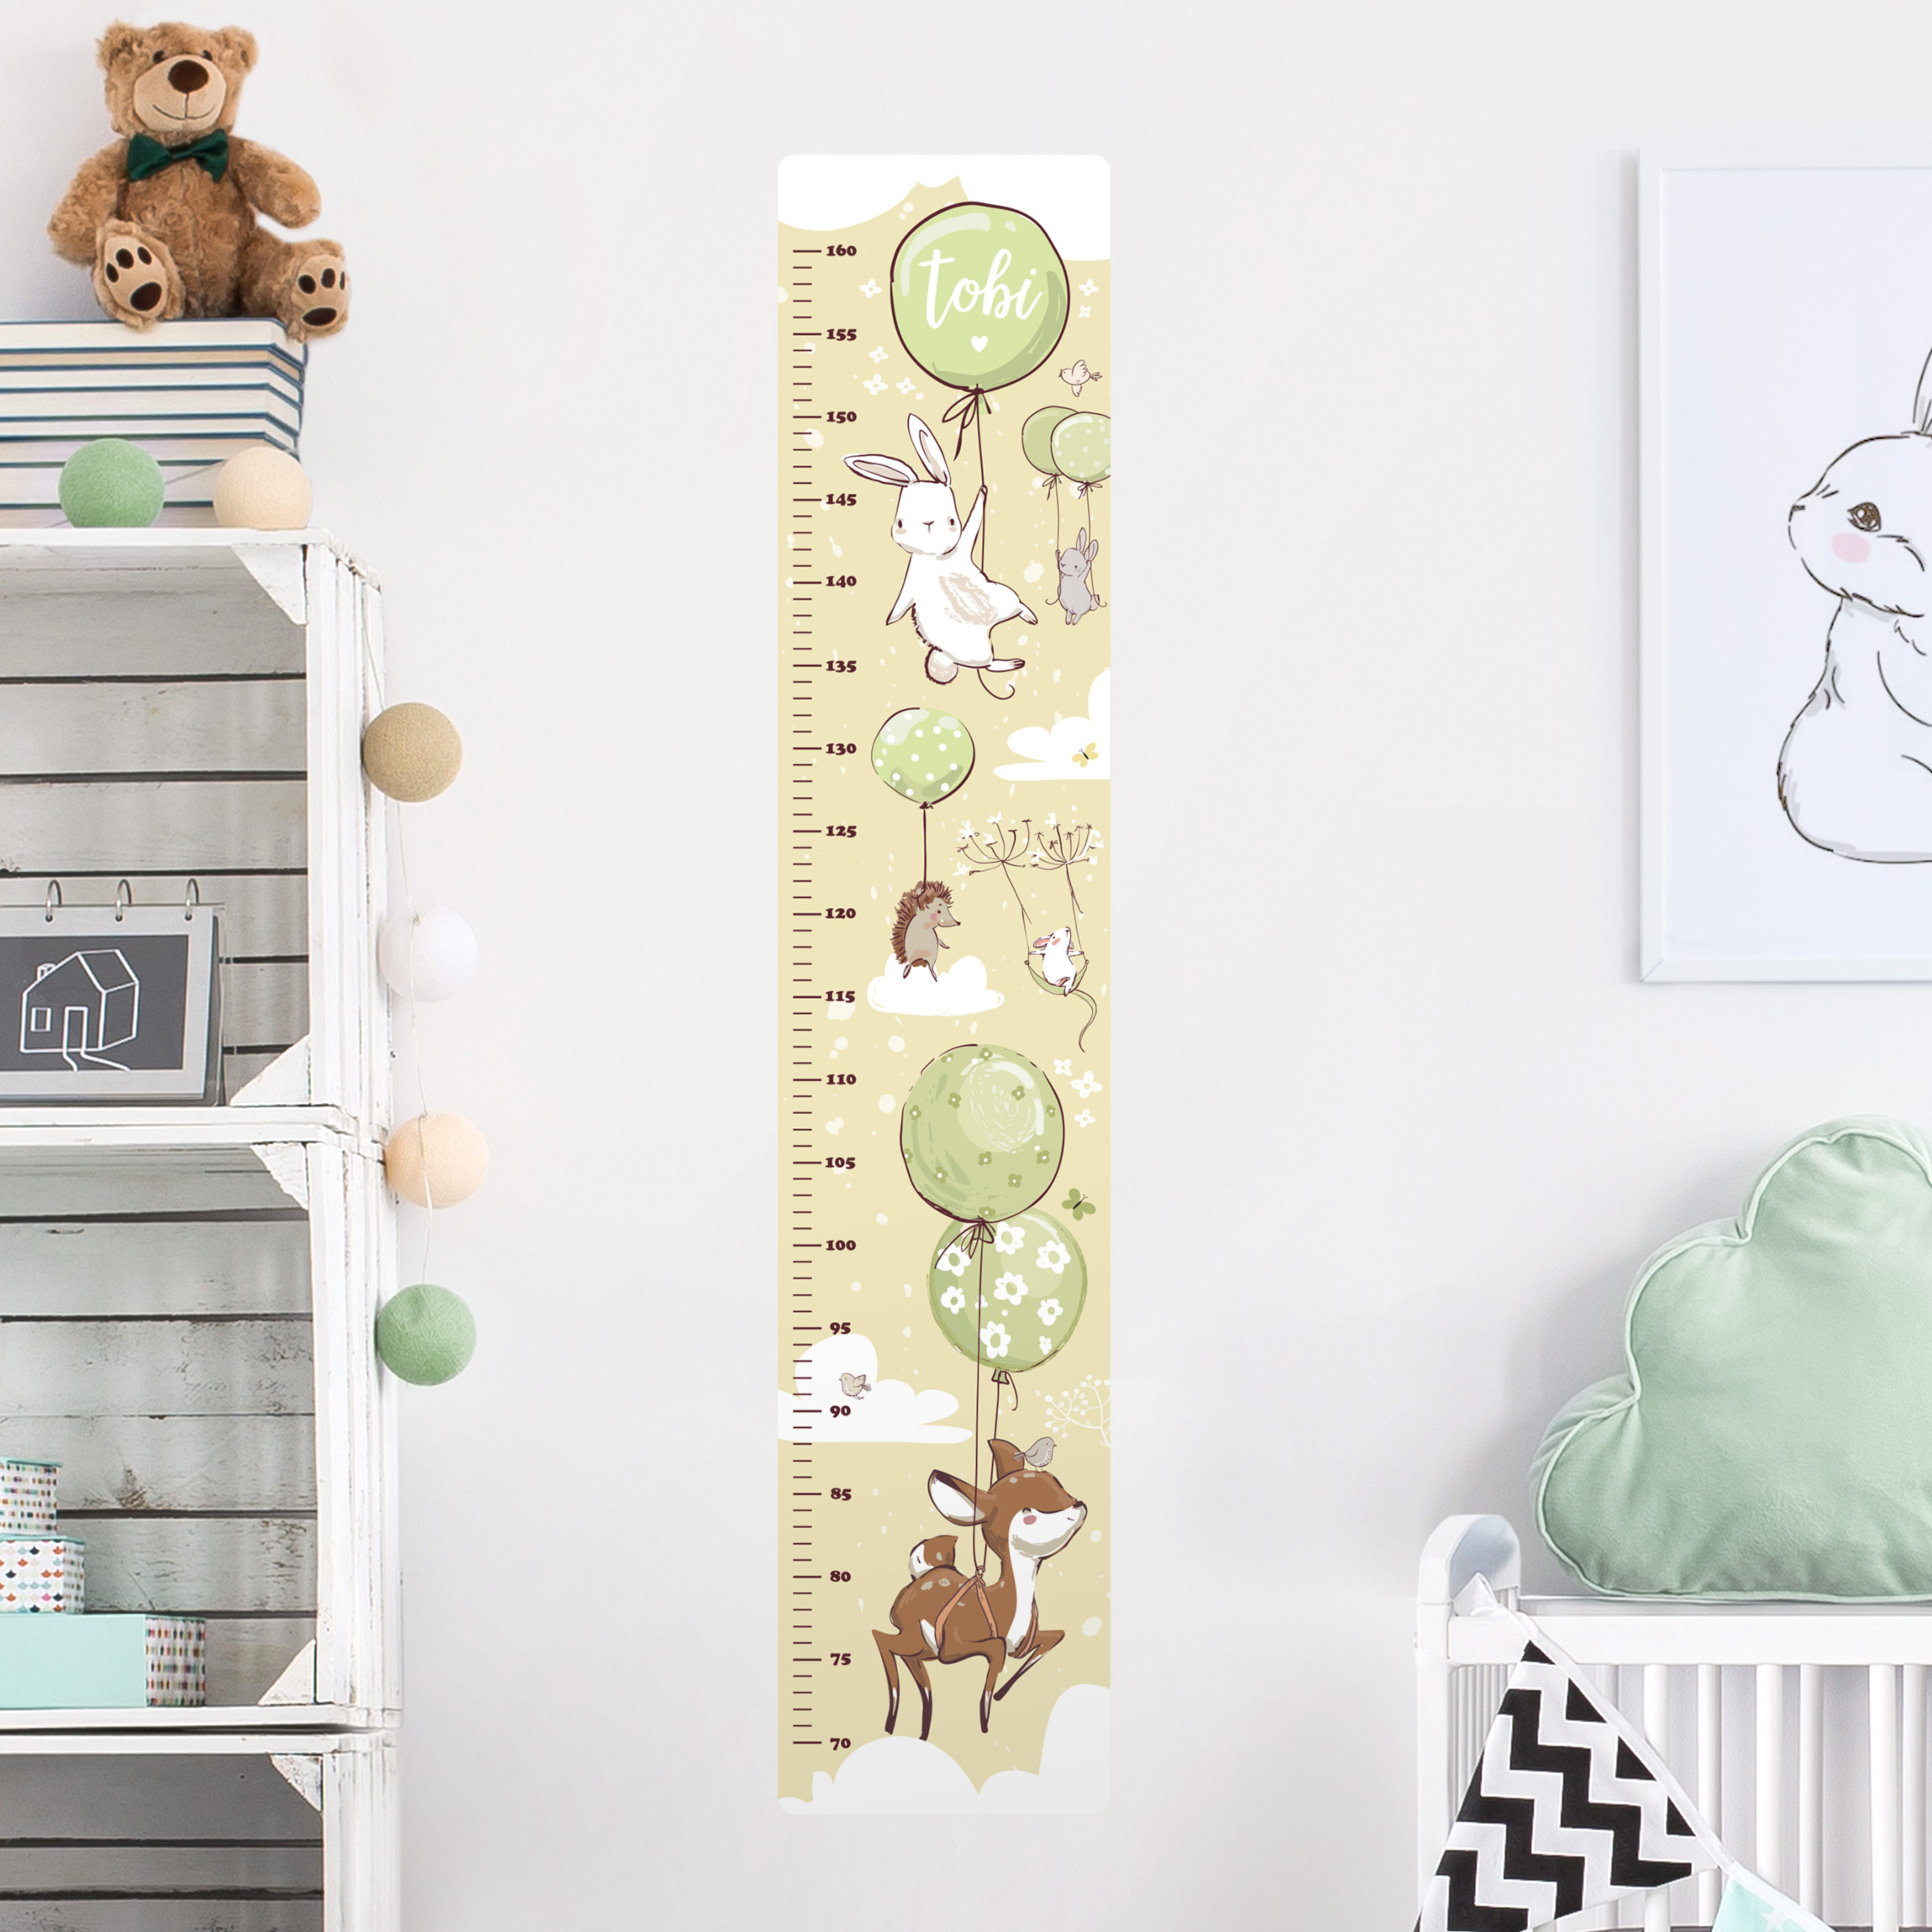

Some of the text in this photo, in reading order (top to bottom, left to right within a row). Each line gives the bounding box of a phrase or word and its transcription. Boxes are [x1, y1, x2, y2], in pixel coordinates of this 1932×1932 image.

[826, 244, 857, 257] 160
[919, 249, 1042, 328] tobi
[826, 328, 857, 342] 155
[826, 411, 857, 424] 150
[826, 492, 857, 507] 145
[826, 575, 857, 588] 140
[826, 659, 857, 673] 135
[825, 743, 857, 756] 130
[825, 825, 857, 838] 125
[825, 907, 857, 920] 120
[825, 990, 856, 1004] 115
[825, 1074, 857, 1086] 110
[825, 1157, 856, 1170] 105
[825, 1239, 857, 1252] 100
[829, 1321, 851, 1336] 95
[829, 1404, 851, 1418] 90
[829, 1487, 852, 1501] 85
[829, 1570, 852, 1583] 80
[829, 1652, 852, 1667] 75
[829, 1737, 852, 1751] 70
